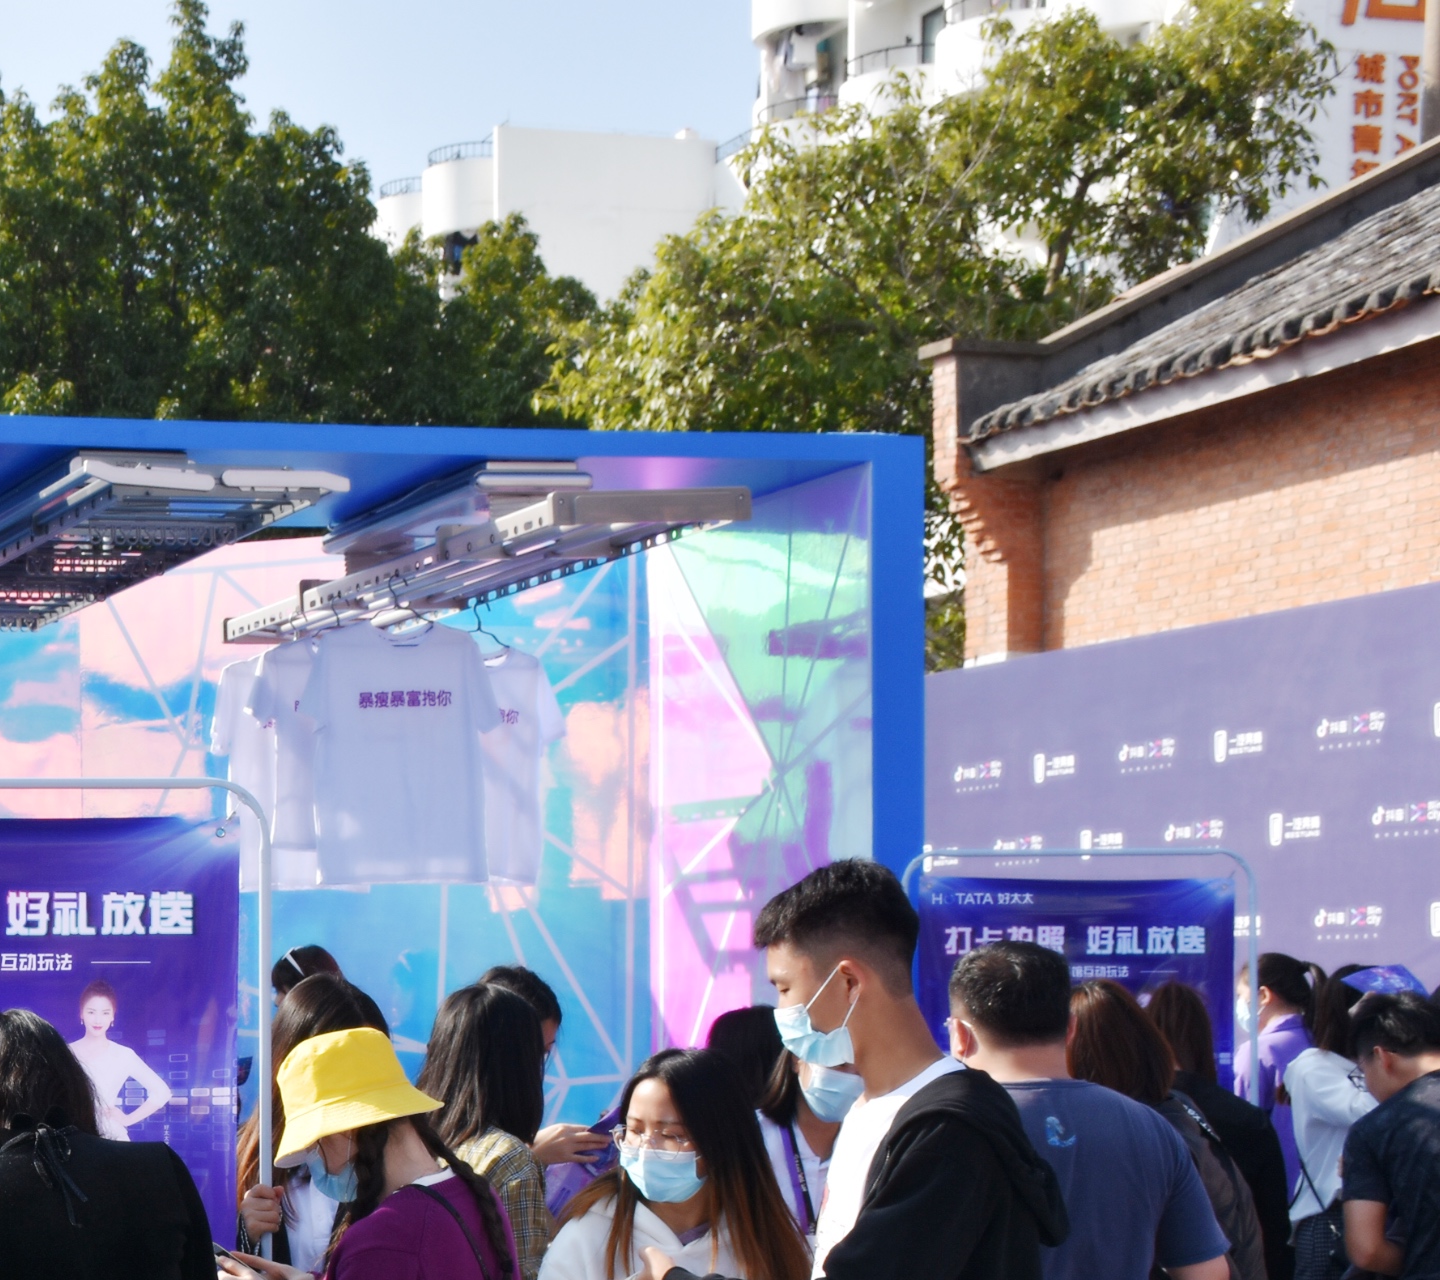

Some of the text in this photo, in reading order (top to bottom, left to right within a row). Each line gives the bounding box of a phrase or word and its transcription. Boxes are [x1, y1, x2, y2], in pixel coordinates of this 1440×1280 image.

[359, 690, 452, 708] 暴瘦暴富抱你
[997, 892, 1034, 905] 好太太
[6, 890, 194, 937] 好礼放送
[1086, 926, 1206, 955] 好礼放送
[1069, 966, 1129, 978] 馆互动玩法
